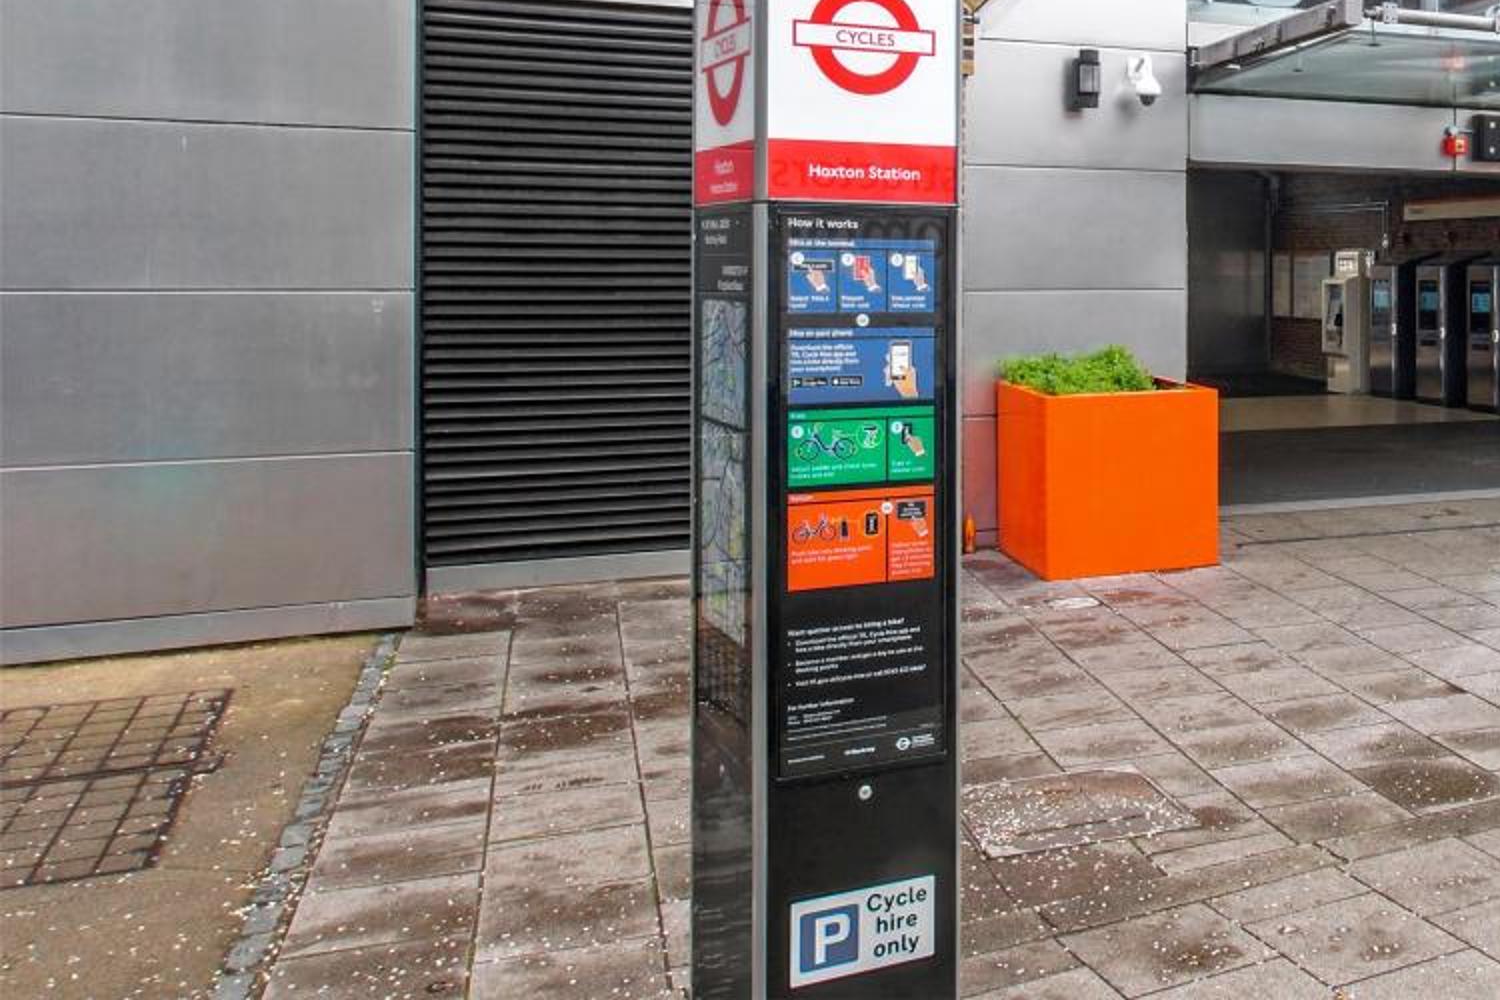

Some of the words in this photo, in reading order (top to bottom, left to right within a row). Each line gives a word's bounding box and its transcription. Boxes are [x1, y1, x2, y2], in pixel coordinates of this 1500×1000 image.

[835, 28, 896, 48] CYCLES
[807, 163, 865, 180] Hoxton
[868, 164, 922, 181] Station
[787, 217, 812, 228] How
[815, 217, 824, 228] it
[827, 219, 859, 230] works
[866, 886, 928, 912] Cycle
[876, 913, 918, 934] hire
[814, 913, 850, 966] P
[873, 934, 920, 958] only
